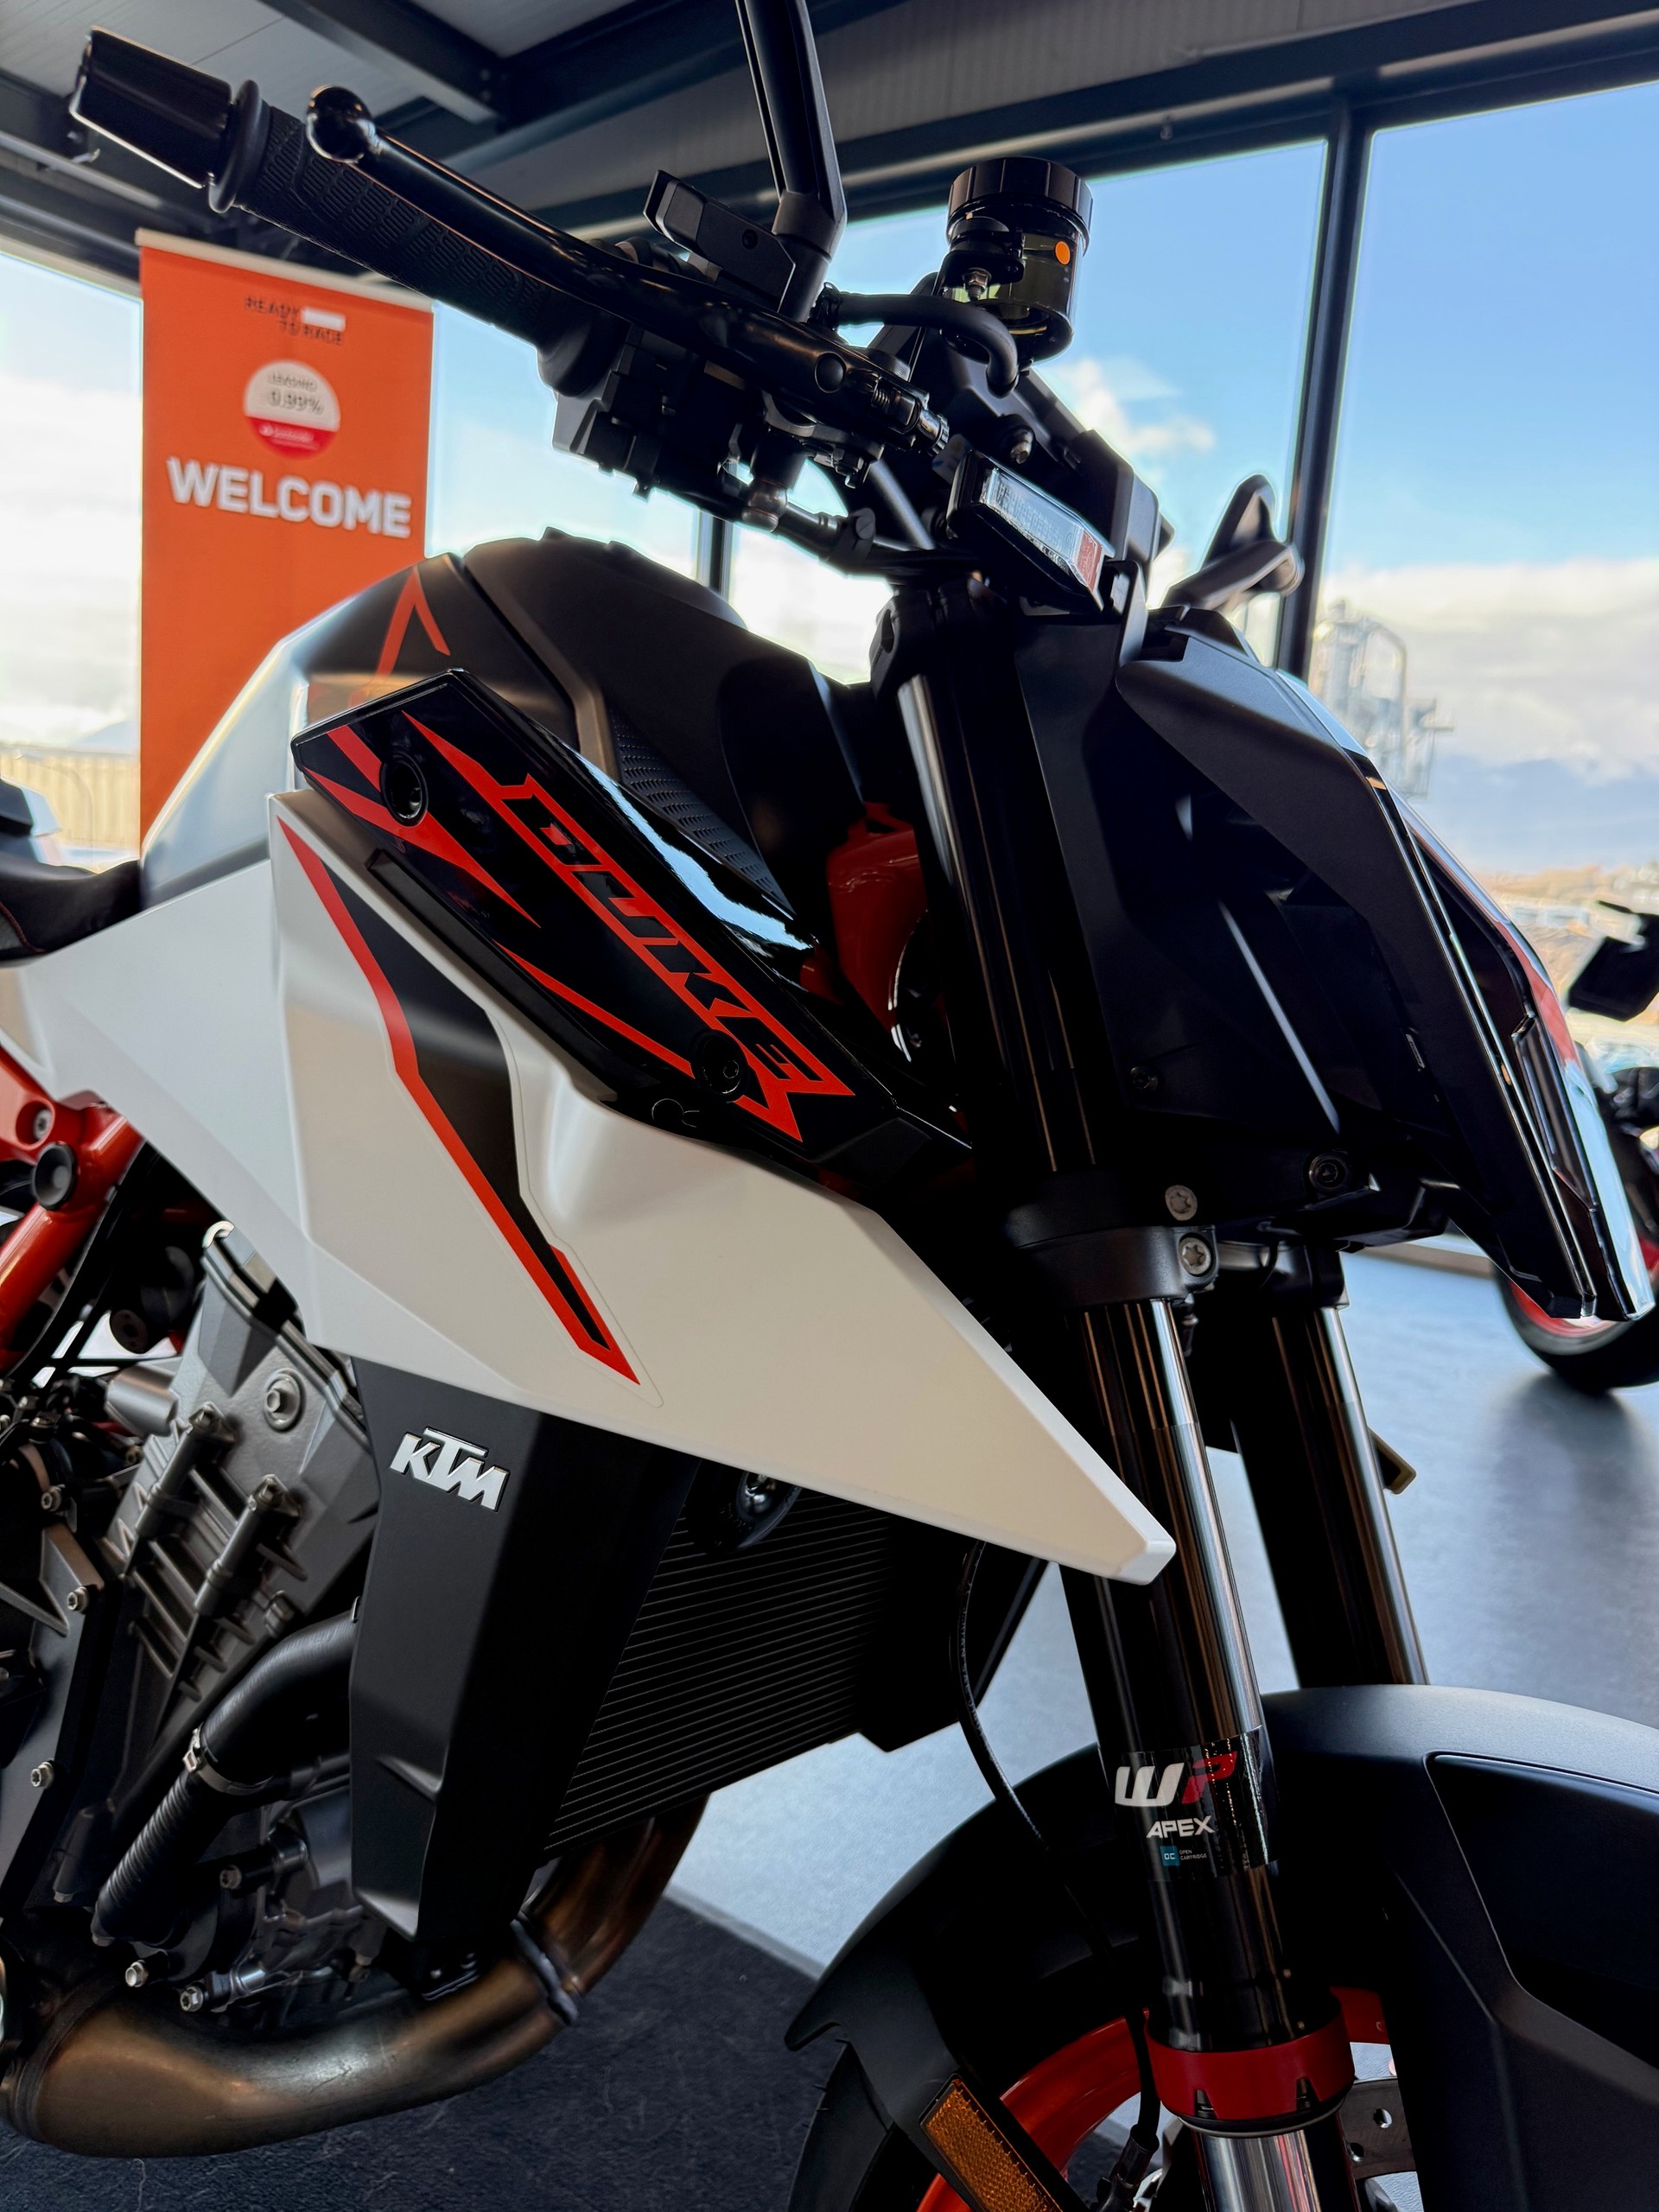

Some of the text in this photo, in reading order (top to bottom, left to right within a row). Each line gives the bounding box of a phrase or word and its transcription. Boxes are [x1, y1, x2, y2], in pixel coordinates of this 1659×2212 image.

[245, 296, 300, 319] READY
[167, 456, 412, 537] WELCOME
[497, 772, 855, 1142] DUKE
[390, 1427, 510, 1512] KTM
[1115, 1751, 1237, 1807] WP
[1146, 1815, 1215, 1839] APEX
[1164, 1852, 1175, 1860] OC
